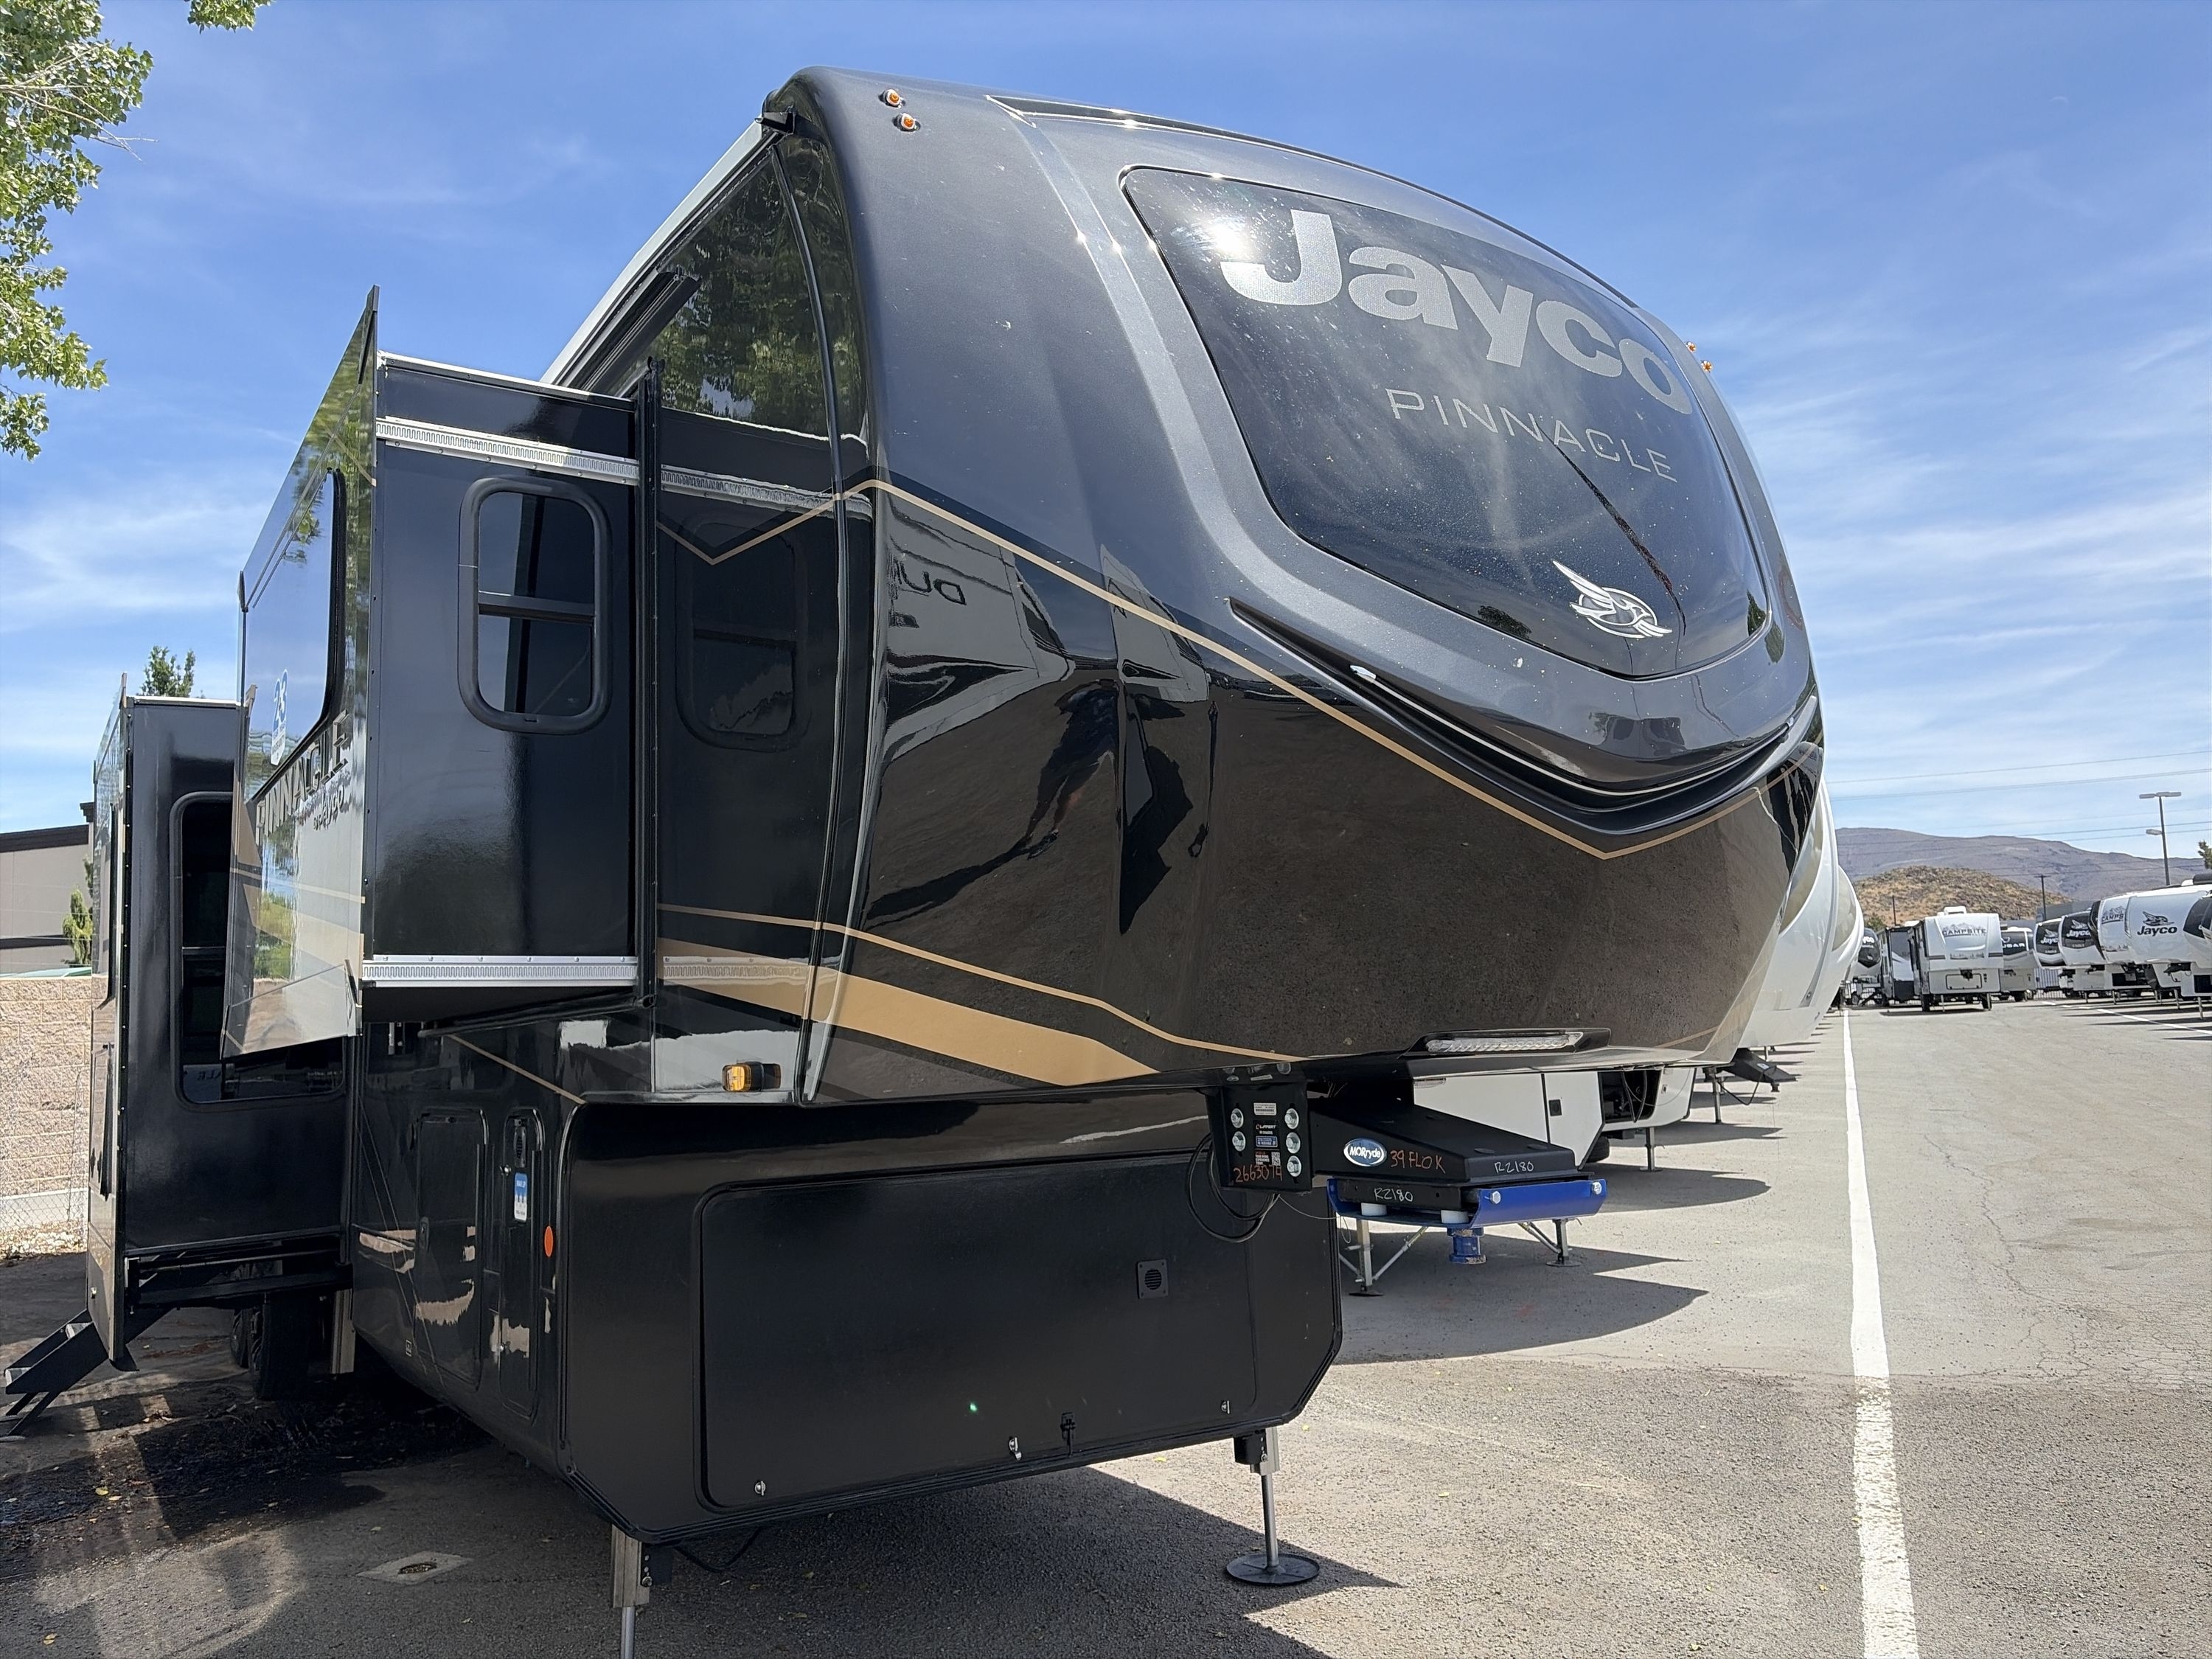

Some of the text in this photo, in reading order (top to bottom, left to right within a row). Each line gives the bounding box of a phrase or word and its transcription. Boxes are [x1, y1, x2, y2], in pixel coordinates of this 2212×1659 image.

[1220, 209, 1693, 414] Jayco
[1385, 388, 1678, 483] PINNACLE
[255, 708, 349, 848] PINNACLE
[2101, 913, 2124, 921] CAMPS
[2137, 925, 2178, 937] Jayco
[1349, 1144, 1381, 1161] MORryde
